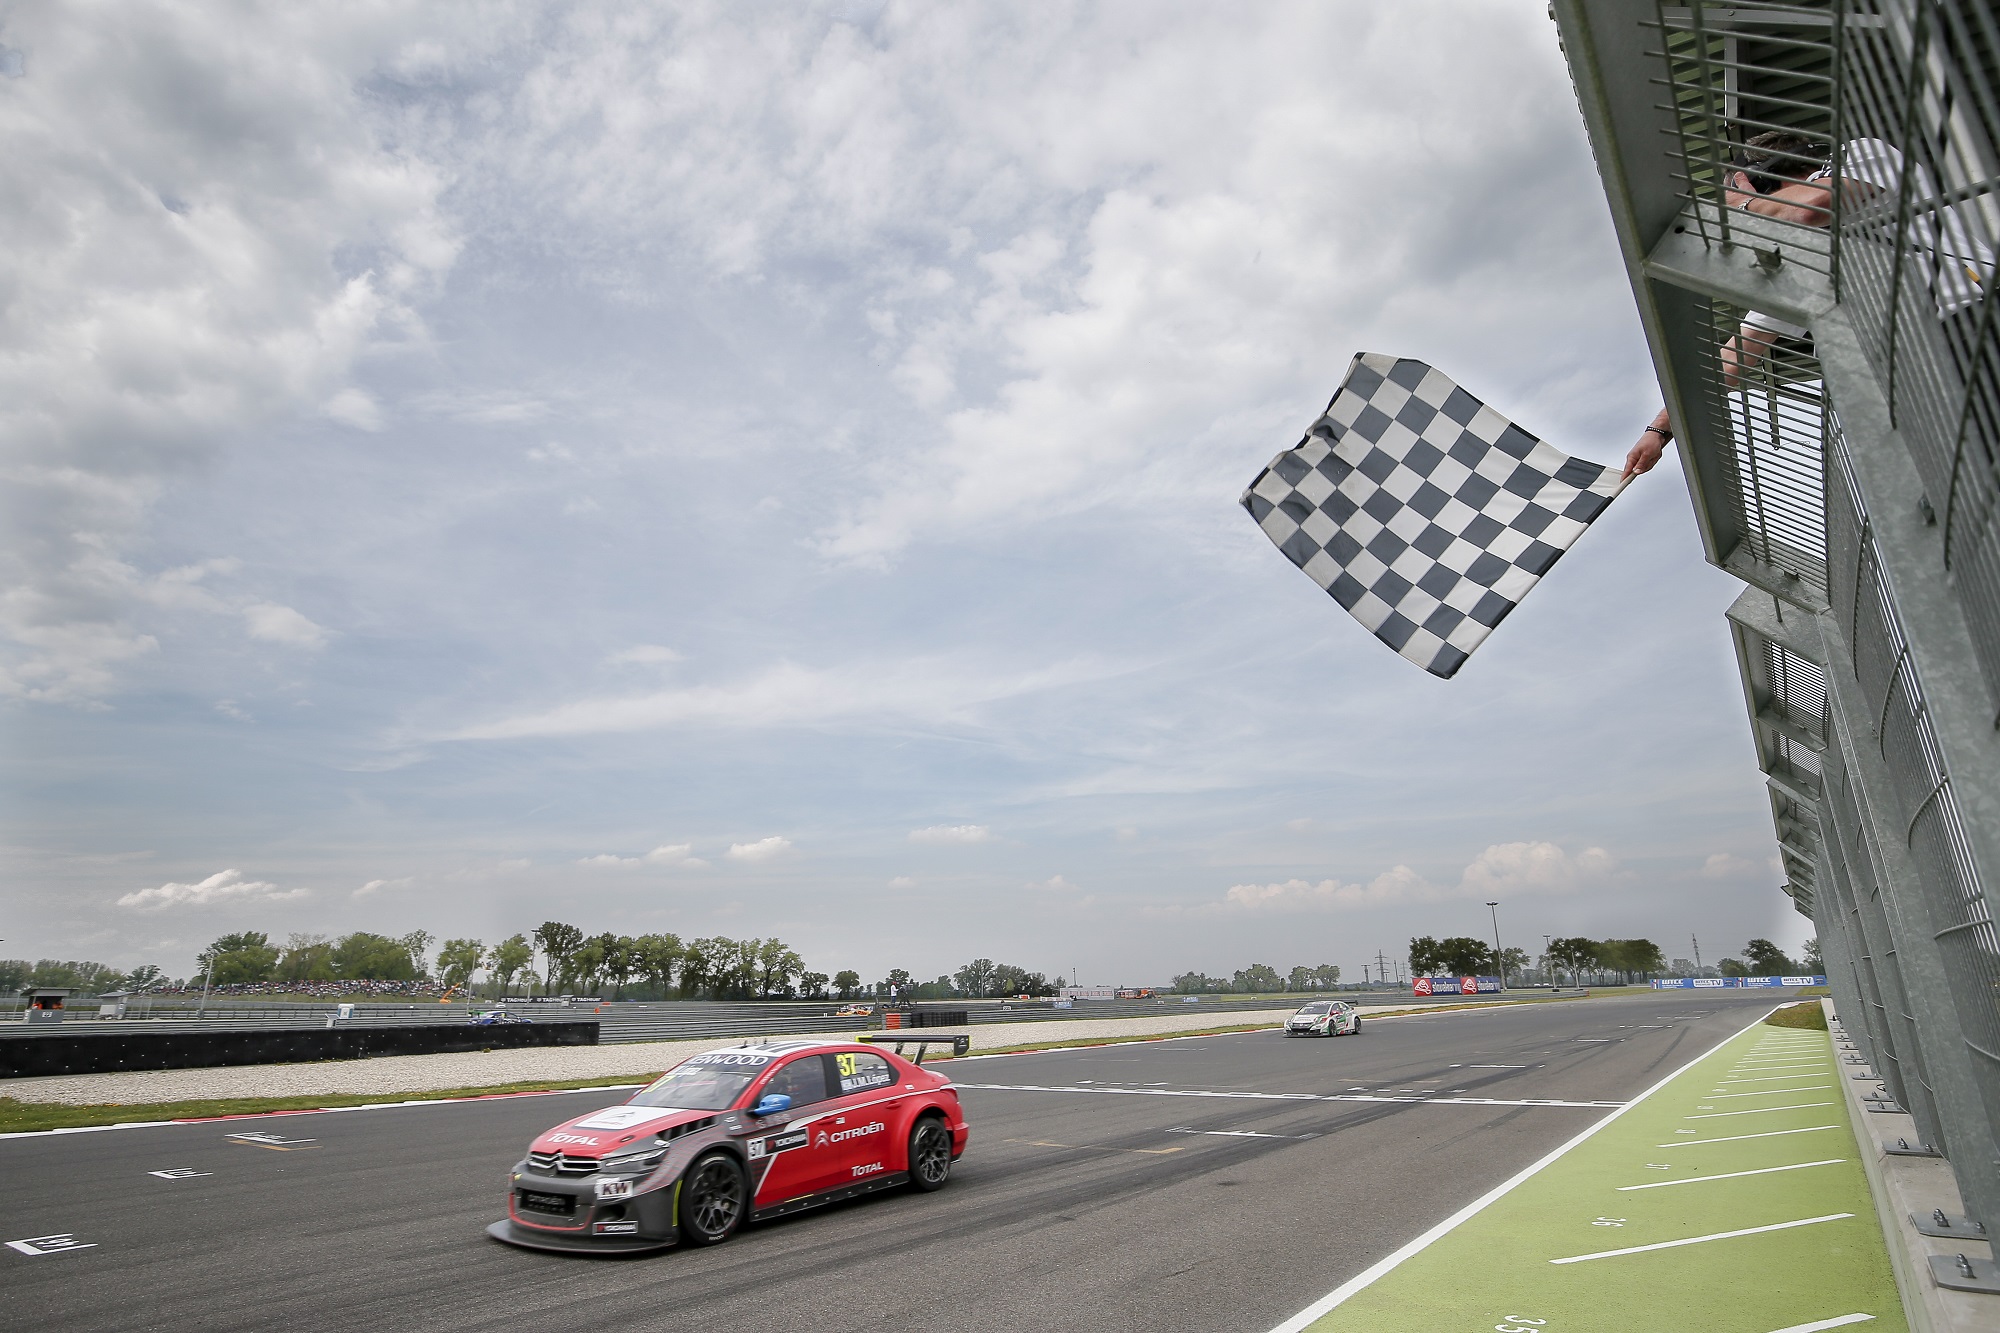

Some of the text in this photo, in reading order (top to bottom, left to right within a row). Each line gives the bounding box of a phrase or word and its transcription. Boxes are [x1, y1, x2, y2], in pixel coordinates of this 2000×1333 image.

[836, 1053, 857, 1077] 37
[547, 1132, 600, 1146] TOTAL
[851, 1161, 885, 1177] TOTAL
[602, 1182, 629, 1196] KW
